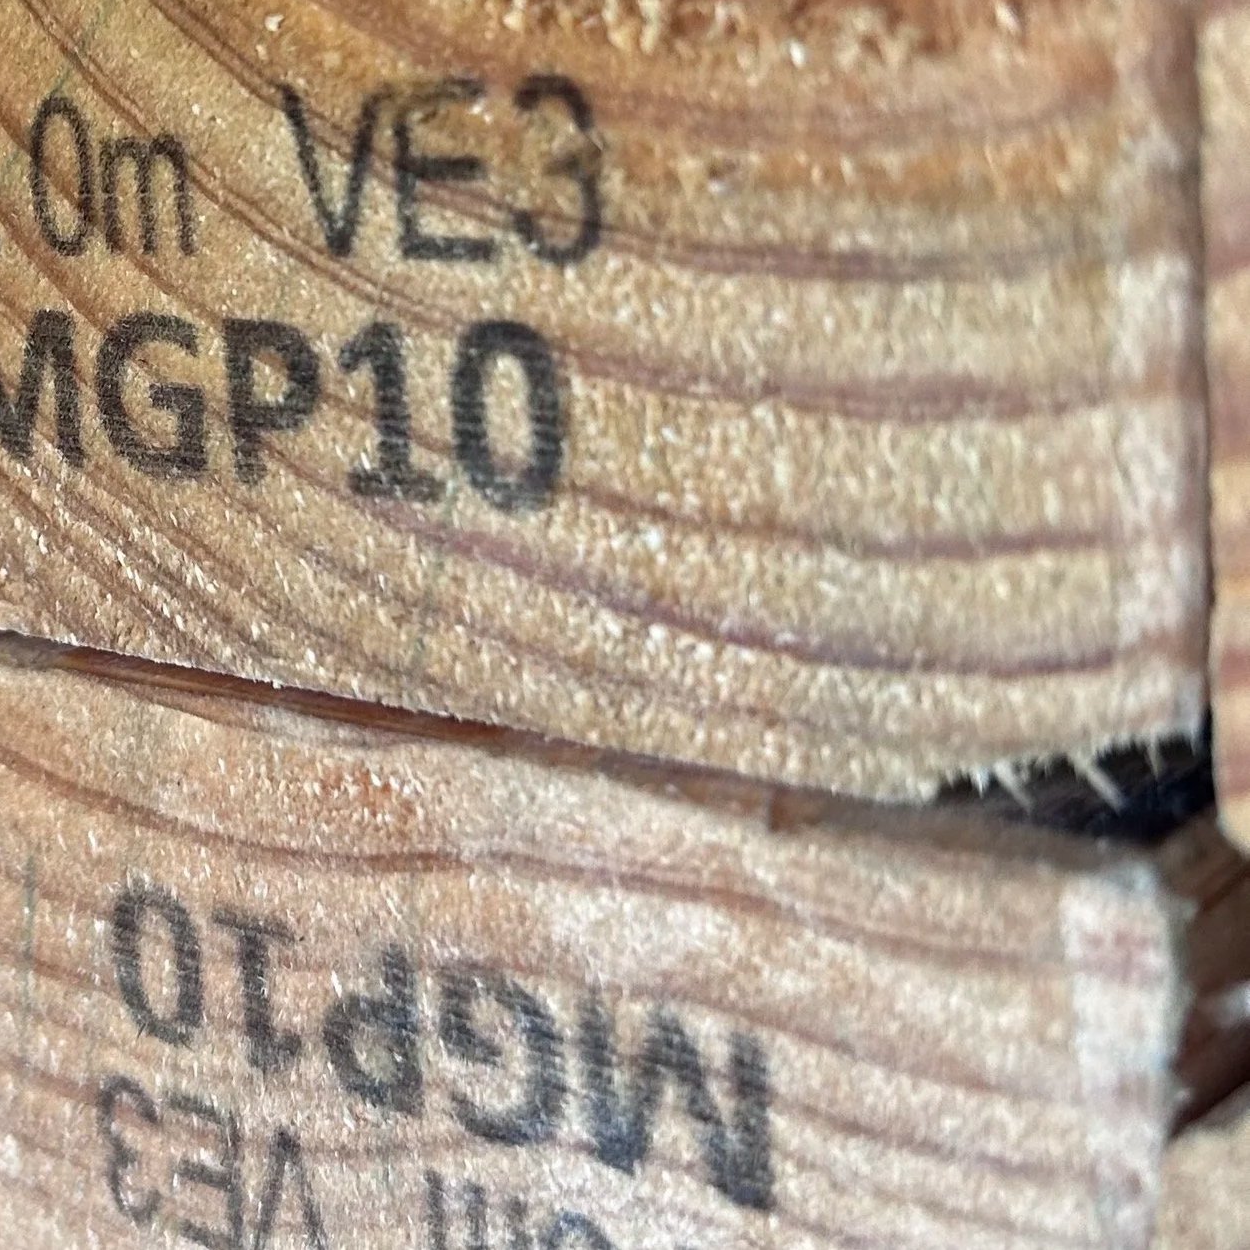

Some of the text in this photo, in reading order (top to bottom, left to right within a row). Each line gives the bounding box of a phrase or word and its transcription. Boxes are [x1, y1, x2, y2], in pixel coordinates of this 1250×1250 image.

[280, 72, 608, 266] VE3
[110, 878, 777, 1210] MGP10
[98, 1072, 330, 1250] VE3
